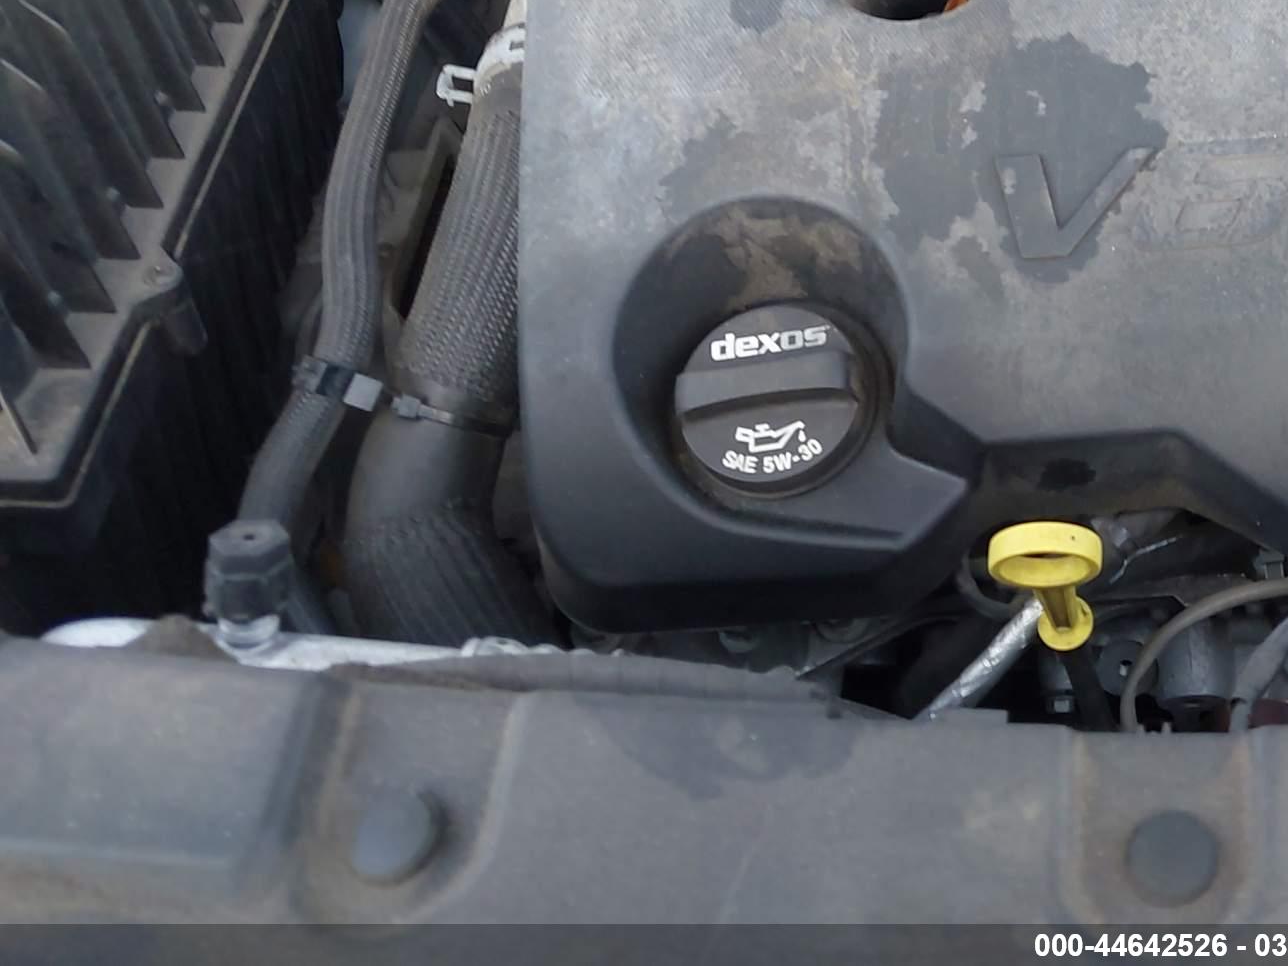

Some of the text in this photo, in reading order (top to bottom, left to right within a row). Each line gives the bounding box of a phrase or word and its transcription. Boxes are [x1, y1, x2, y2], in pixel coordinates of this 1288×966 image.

[710, 325, 829, 362] dexos
[721, 438, 823, 474] SAE 5W-30
